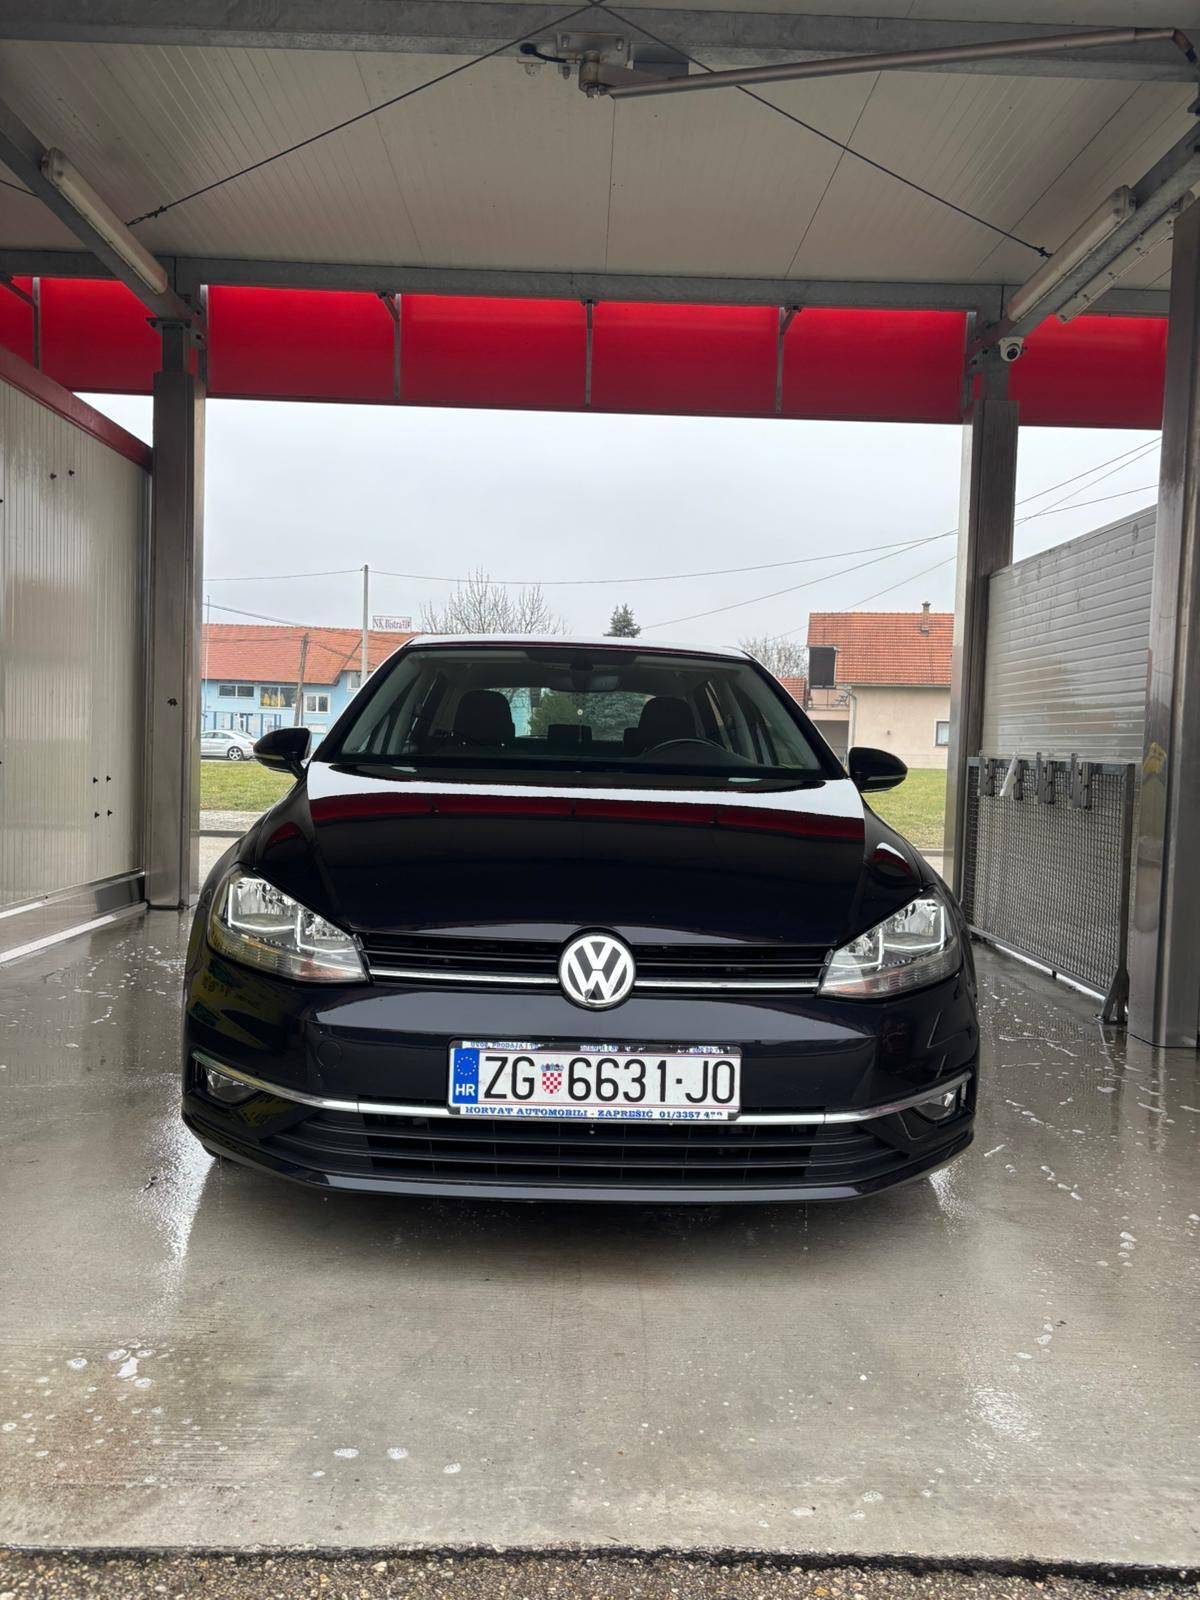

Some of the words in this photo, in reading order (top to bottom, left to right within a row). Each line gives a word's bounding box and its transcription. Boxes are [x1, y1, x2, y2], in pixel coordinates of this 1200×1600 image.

[484, 1056, 535, 1101] ZG
[455, 1083, 476, 1097] HR
[465, 1106, 513, 1114] HORVAT
[516, 1108, 588, 1117] AUTOMOBILI
